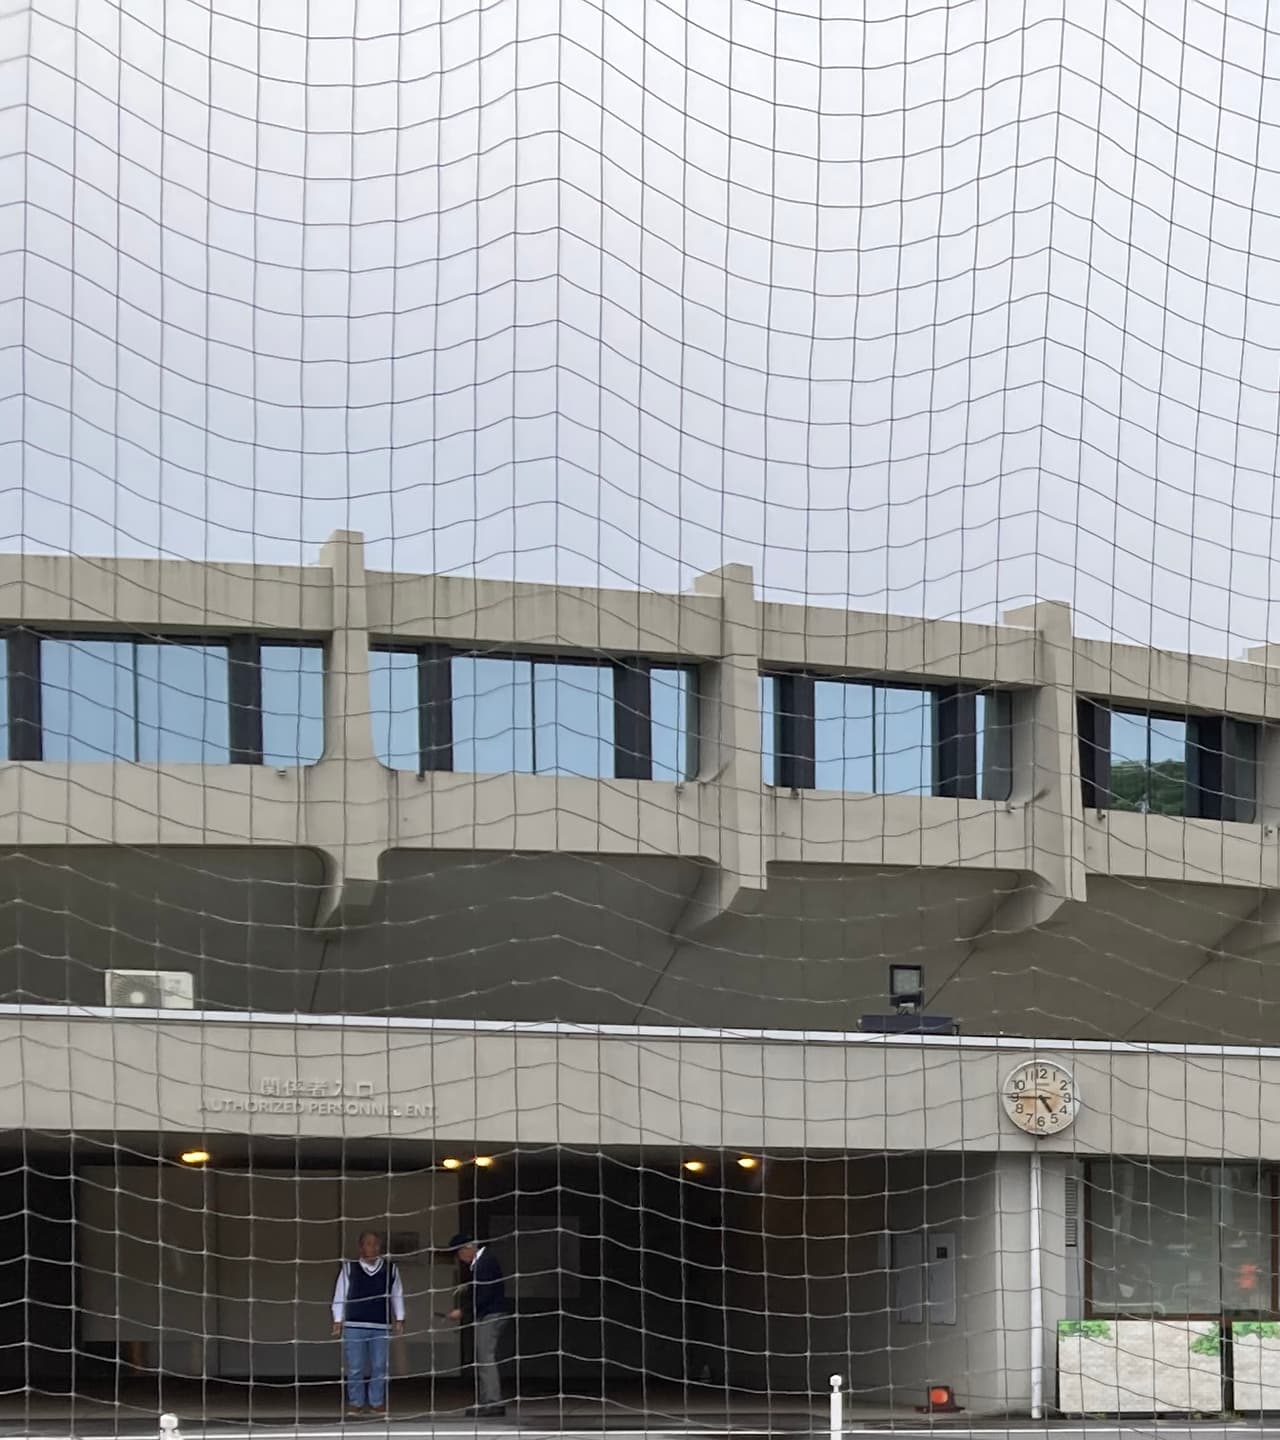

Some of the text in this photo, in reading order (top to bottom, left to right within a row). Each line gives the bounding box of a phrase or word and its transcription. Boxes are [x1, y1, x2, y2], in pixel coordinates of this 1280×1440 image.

[1035, 1068, 1048, 1080] 12
[260, 1077, 375, 1098] 関係者入口
[1011, 1079, 1025, 1091] 10
[1060, 1079, 1068, 1091] 2
[1063, 1092, 1072, 1103] 3
[198, 1099, 305, 1114] AUTHORIZED
[308, 1101, 402, 1117] PERSONNEL
[1015, 1103, 1024, 1114] 8
[1059, 1105, 1068, 1115] 4
[1026, 1113, 1034, 1123] 7
[1037, 1116, 1046, 1127] 6
[1050, 1113, 1058, 1124] 5
